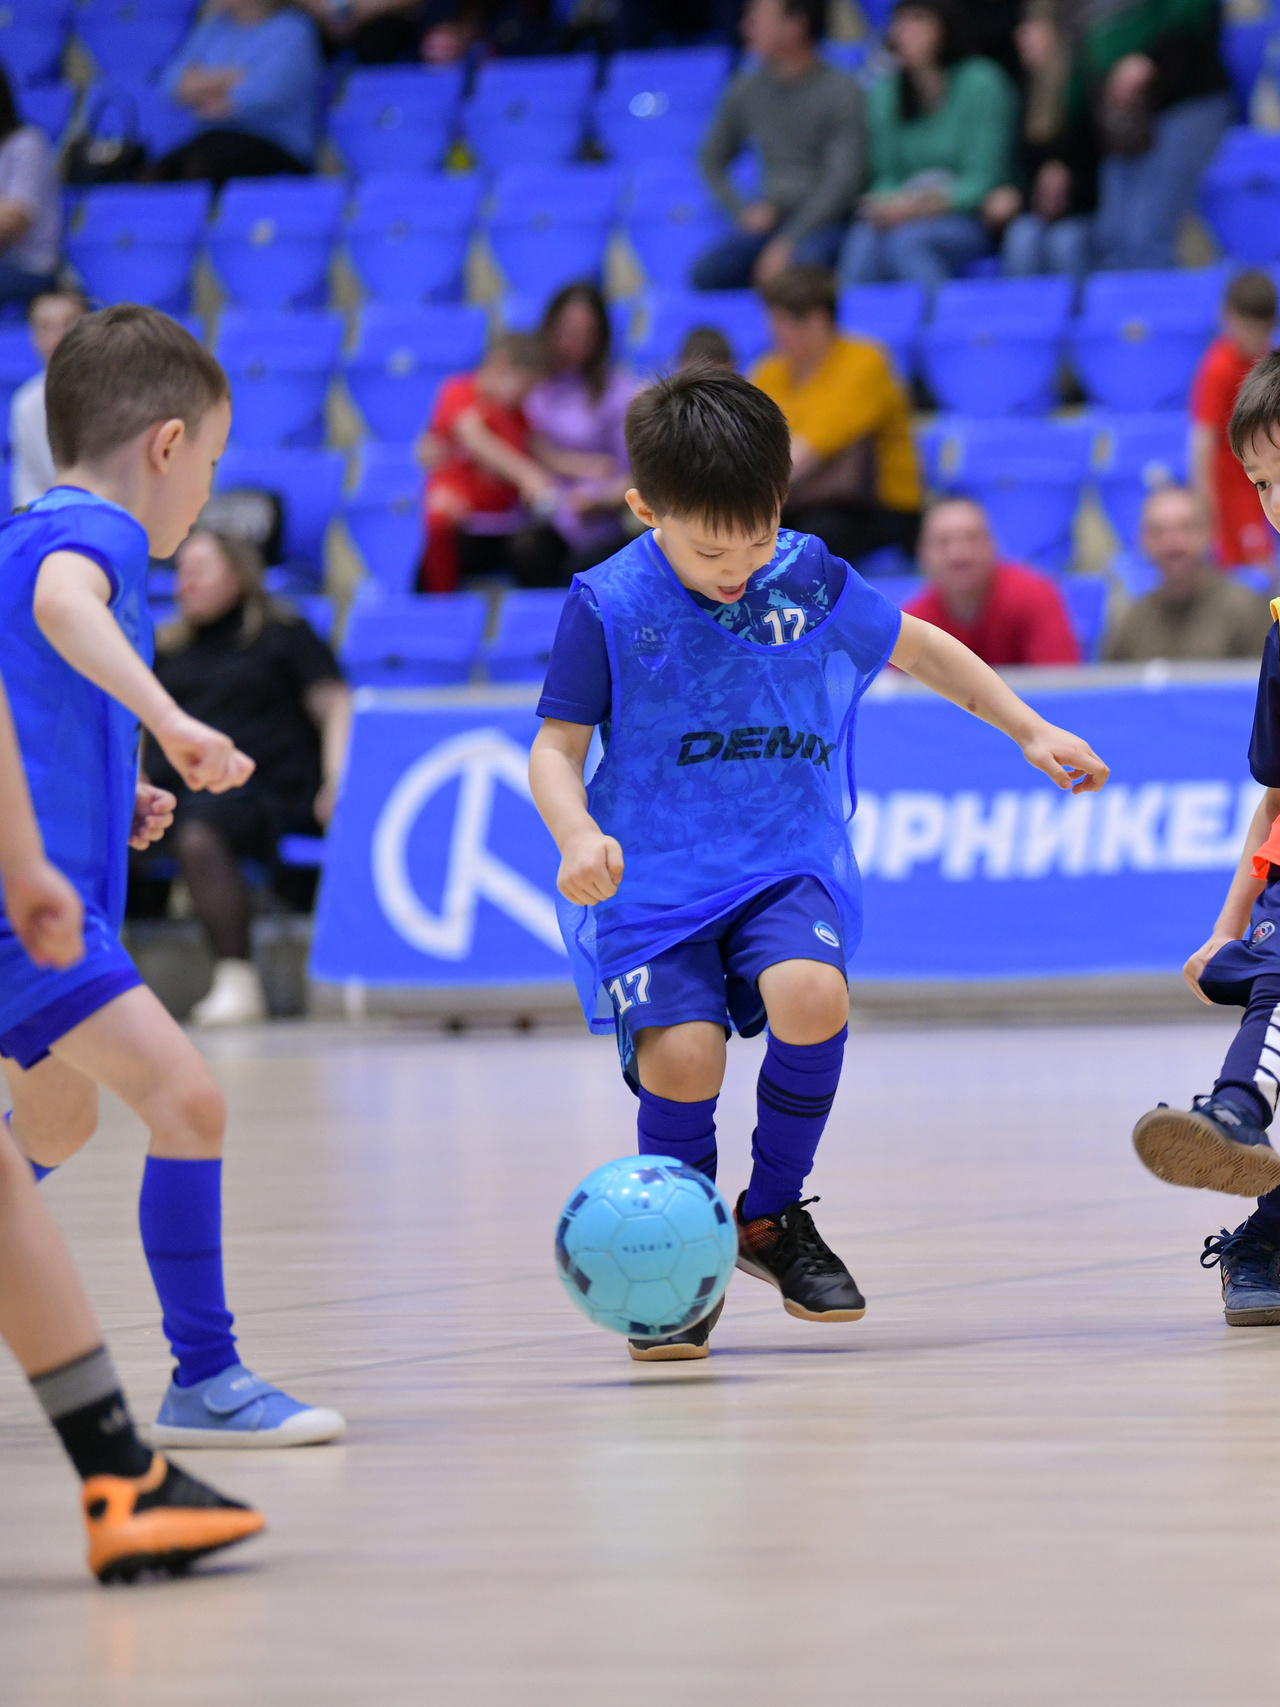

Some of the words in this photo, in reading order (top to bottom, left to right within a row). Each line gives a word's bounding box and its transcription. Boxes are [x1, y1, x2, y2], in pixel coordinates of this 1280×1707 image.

[763, 608, 806, 646] 17
[676, 726, 837, 772] DEMIX
[609, 965, 649, 1016] 17
